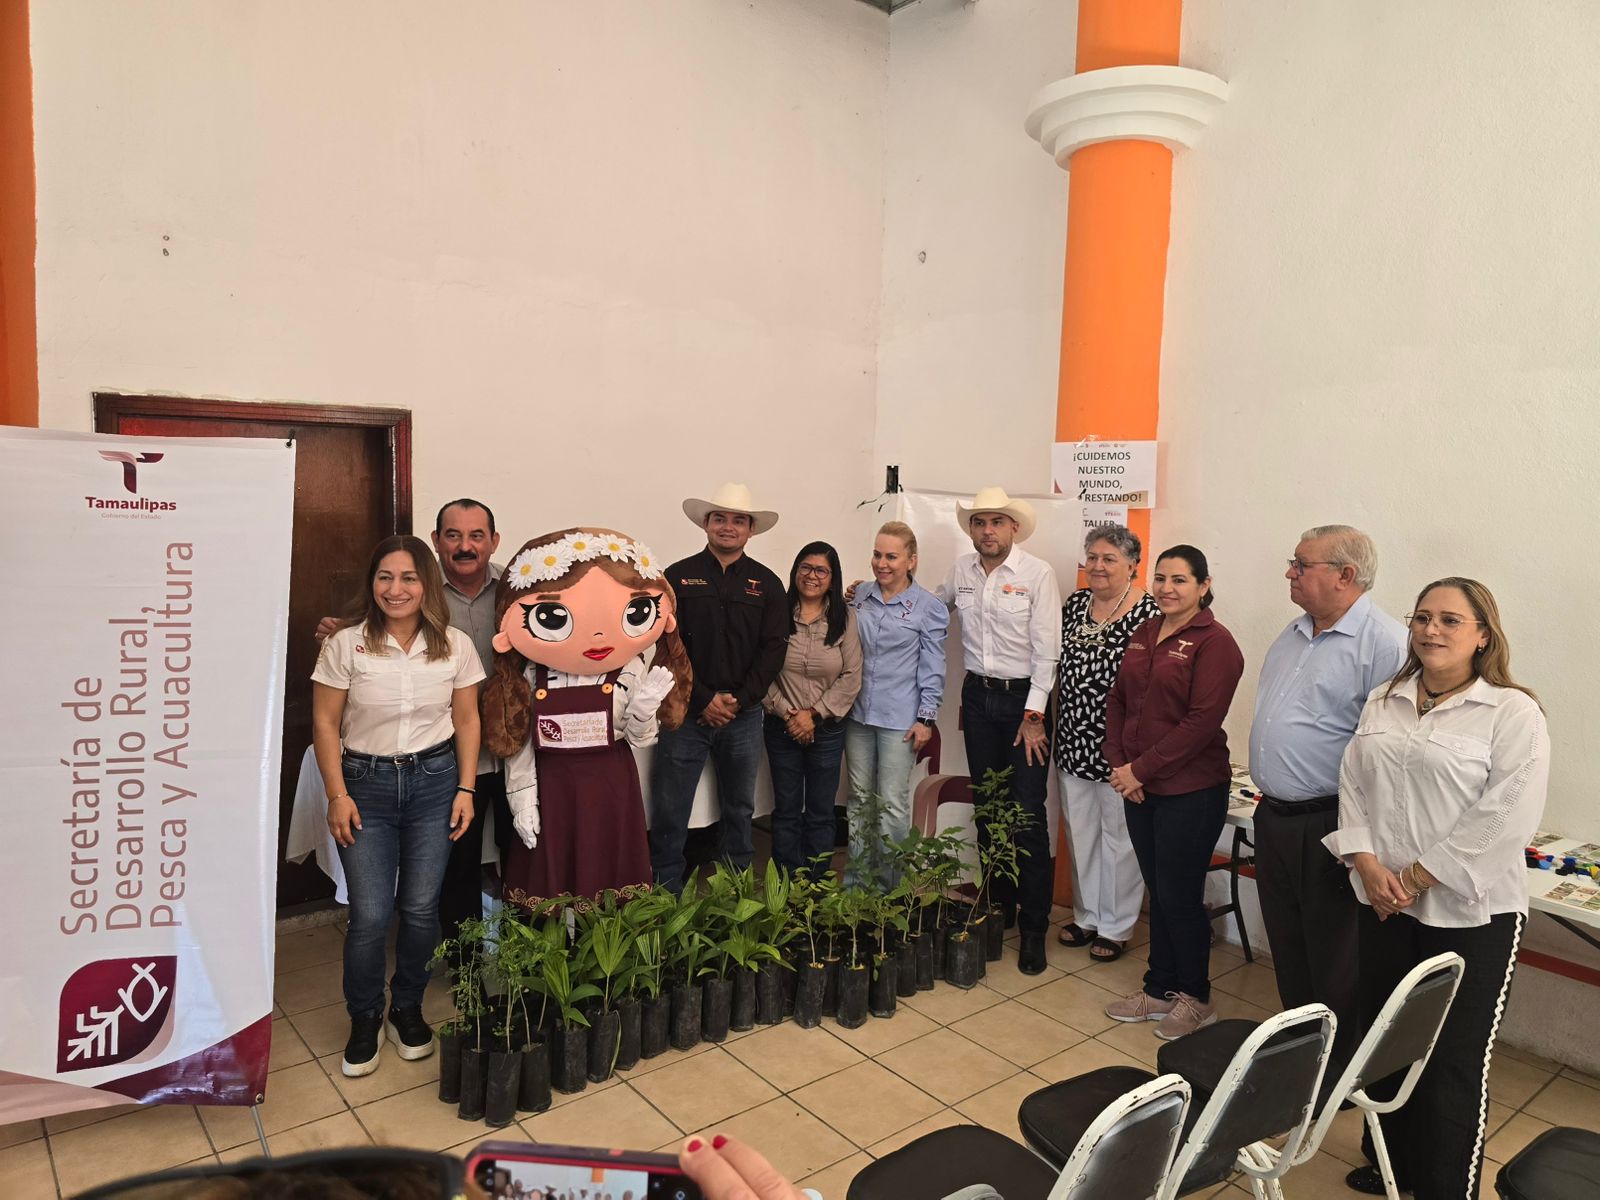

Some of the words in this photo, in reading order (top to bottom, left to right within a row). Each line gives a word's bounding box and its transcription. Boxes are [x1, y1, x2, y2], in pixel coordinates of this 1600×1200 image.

[1073, 452, 1131, 462] ¡CUIDEMOS
[1078, 466, 1125, 475] NUESTRO
[1079, 480, 1122, 489] MUNDO,
[1084, 493, 1142, 502] RESTANDO!
[85, 496, 177, 513] Tamaulipas
[108, 606, 155, 716] Rural,
[153, 542, 193, 770] Acuacultura
[61, 677, 102, 722] de
[162, 783, 197, 805] y
[59, 737, 101, 936] Secretaría
[105, 731, 146, 931] Desarrollo
[150, 819, 187, 928] Pesca
